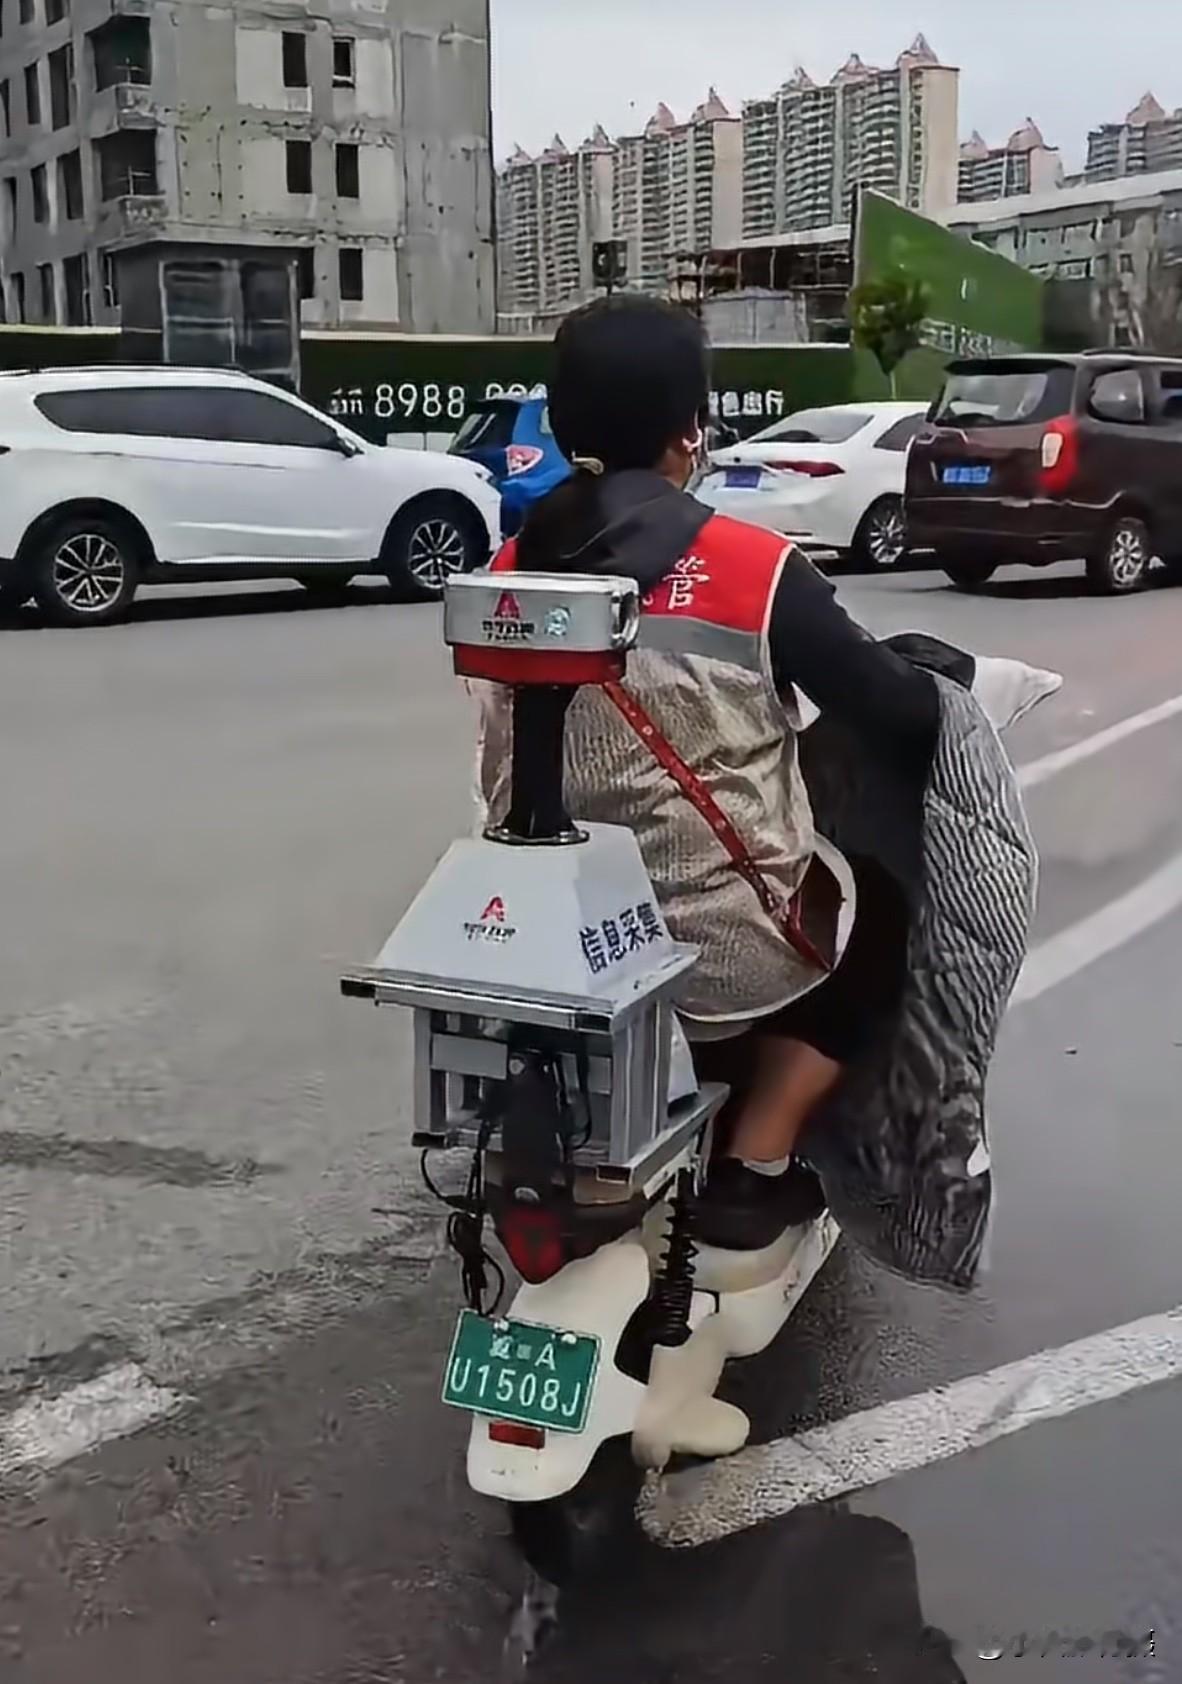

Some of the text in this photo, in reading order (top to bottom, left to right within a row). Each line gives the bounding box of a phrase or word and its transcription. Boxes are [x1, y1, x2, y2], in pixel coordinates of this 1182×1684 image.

[375, 384, 465, 418] 8988
[642, 556, 710, 610] 管
[534, 1343, 556, 1371] A
[450, 1357, 582, 1417] U1508J
